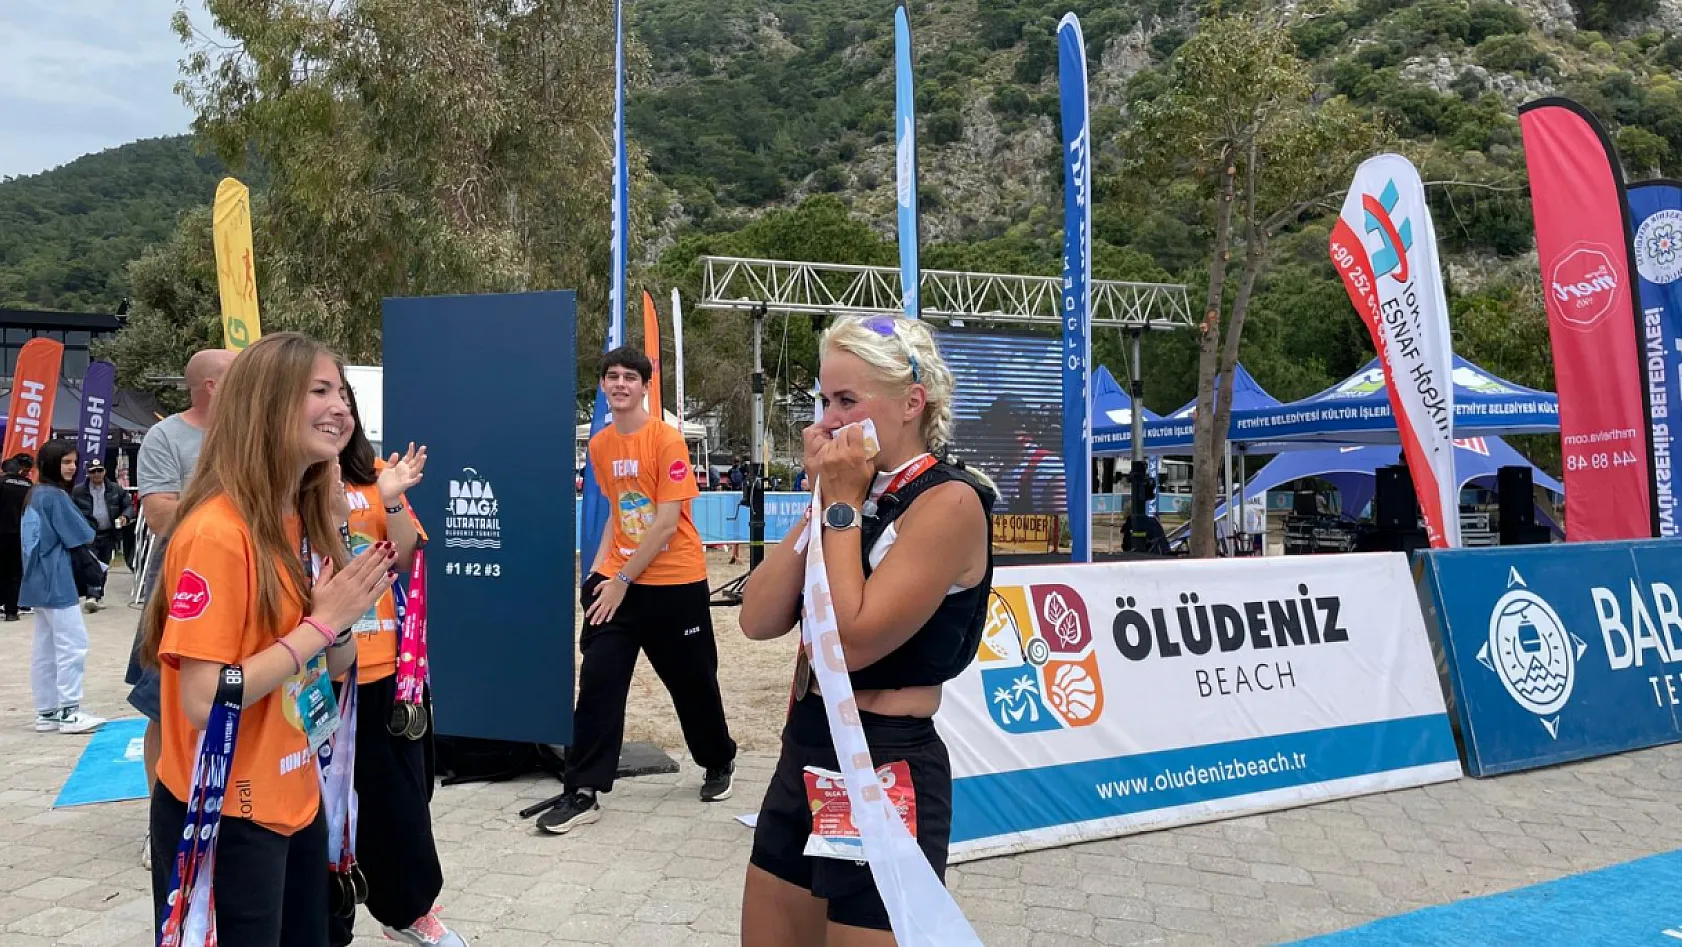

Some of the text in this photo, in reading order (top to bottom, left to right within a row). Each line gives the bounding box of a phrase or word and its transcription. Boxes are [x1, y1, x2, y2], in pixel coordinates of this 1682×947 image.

[1331, 242, 1354, 269] +90
[1348, 267, 1371, 296] 252
[1381, 297, 1420, 360] ESNAF
[1237, 403, 1390, 429] FETHİYE BELEDİYESİ KÜLTÜR İŞLERİ
[1488, 400, 1537, 414] BELEDİYESİ
[612, 459, 639, 477] TEAM
[449, 480, 494, 499] BABA
[445, 517, 501, 530] ULTRATRAIL
[445, 562, 501, 577] #1 #2 #3
[1112, 583, 1348, 661] ÖLÜDENİZ
[1195, 660, 1297, 698] BEACH
[1649, 675, 1682, 708] TE
[1096, 751, 1307, 800] www.oludenizbeach.tr
